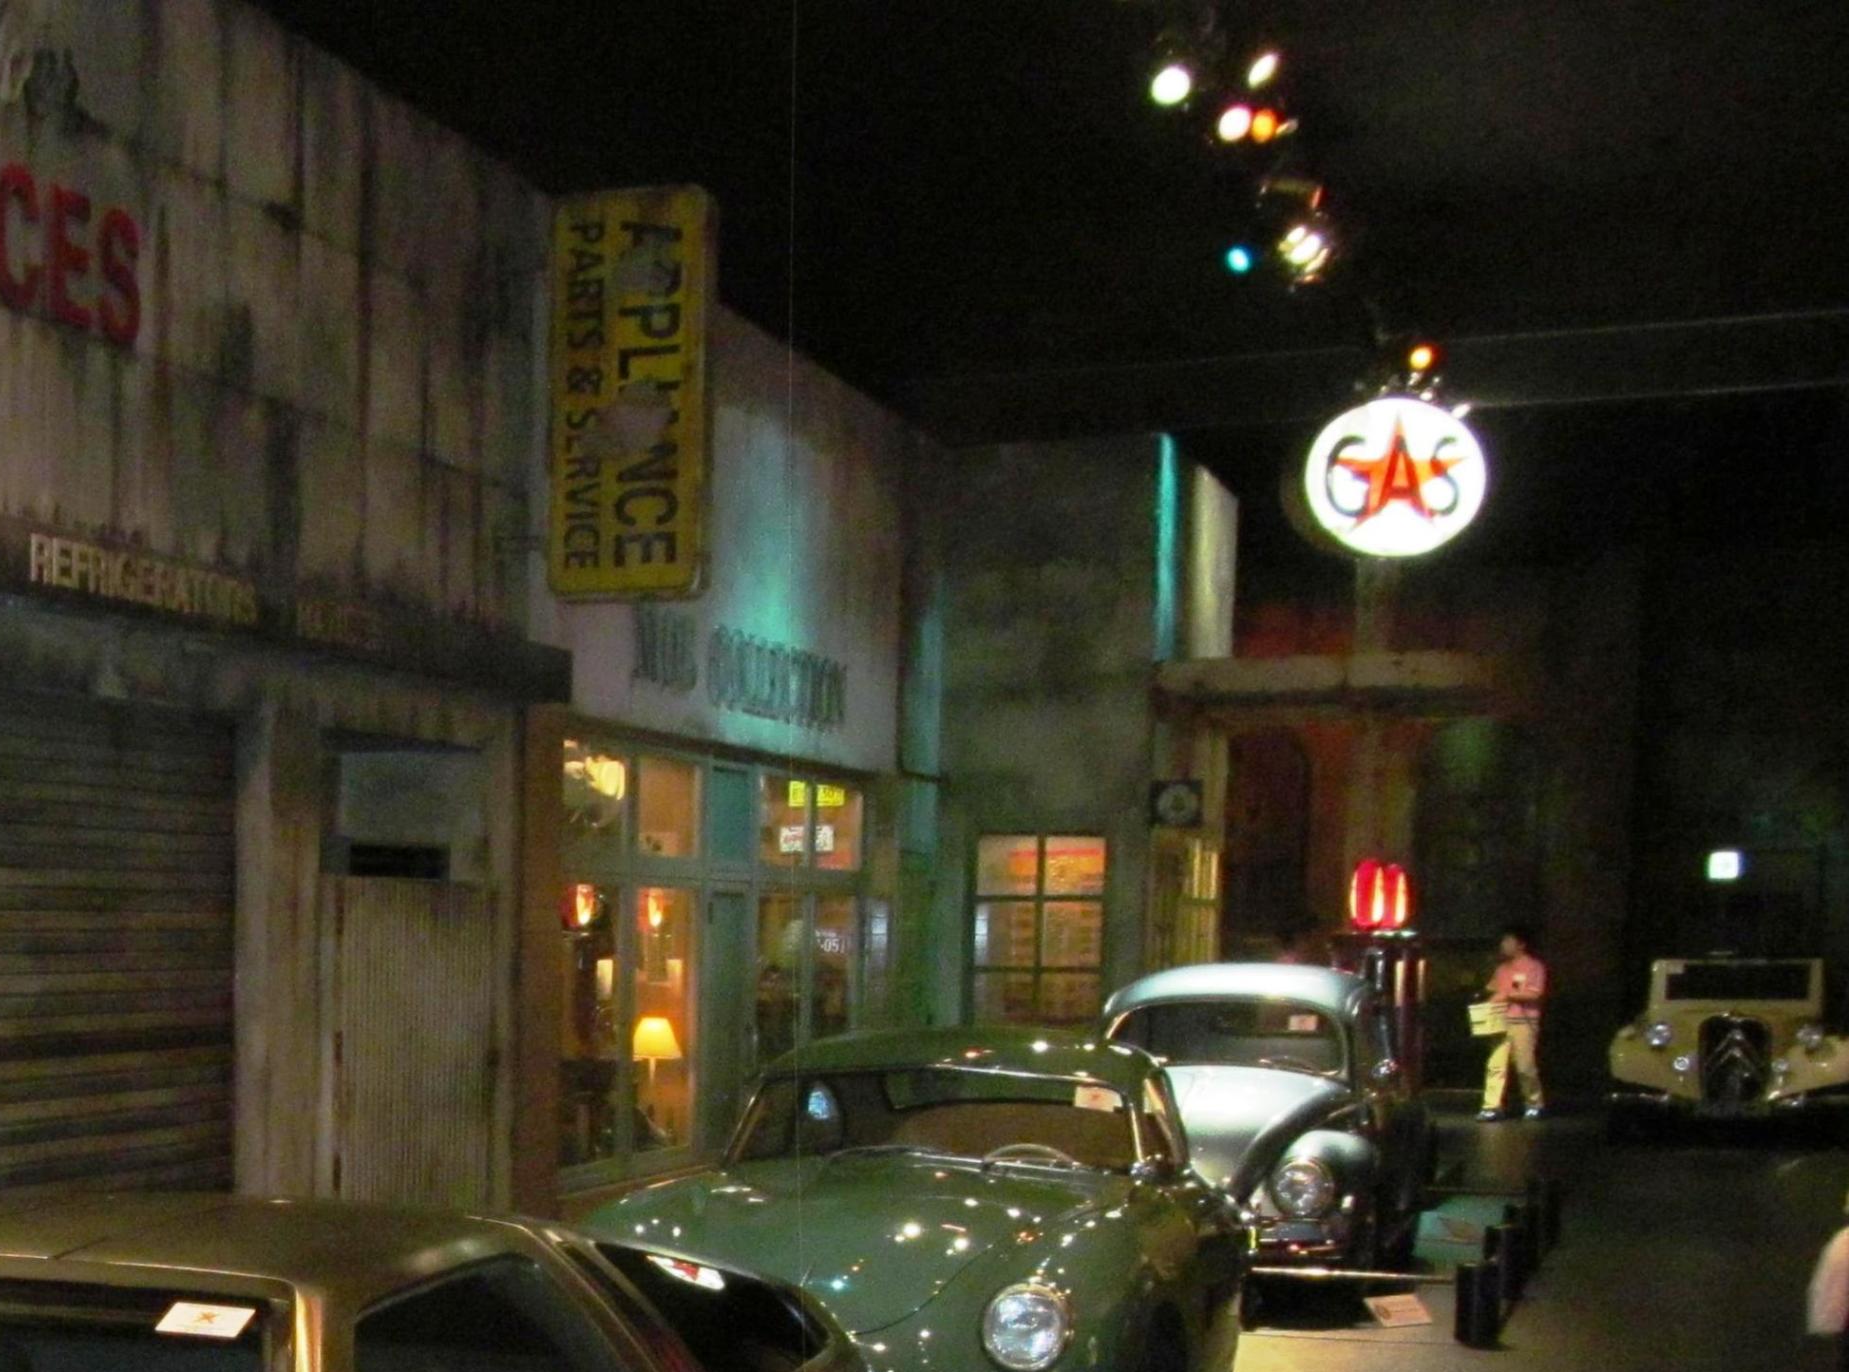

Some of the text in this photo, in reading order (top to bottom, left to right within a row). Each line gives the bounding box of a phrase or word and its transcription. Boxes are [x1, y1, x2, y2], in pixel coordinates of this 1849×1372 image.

[566, 221, 605, 349] PARTS
[566, 366, 603, 395] &
[1325, 433, 1461, 518] GAS
